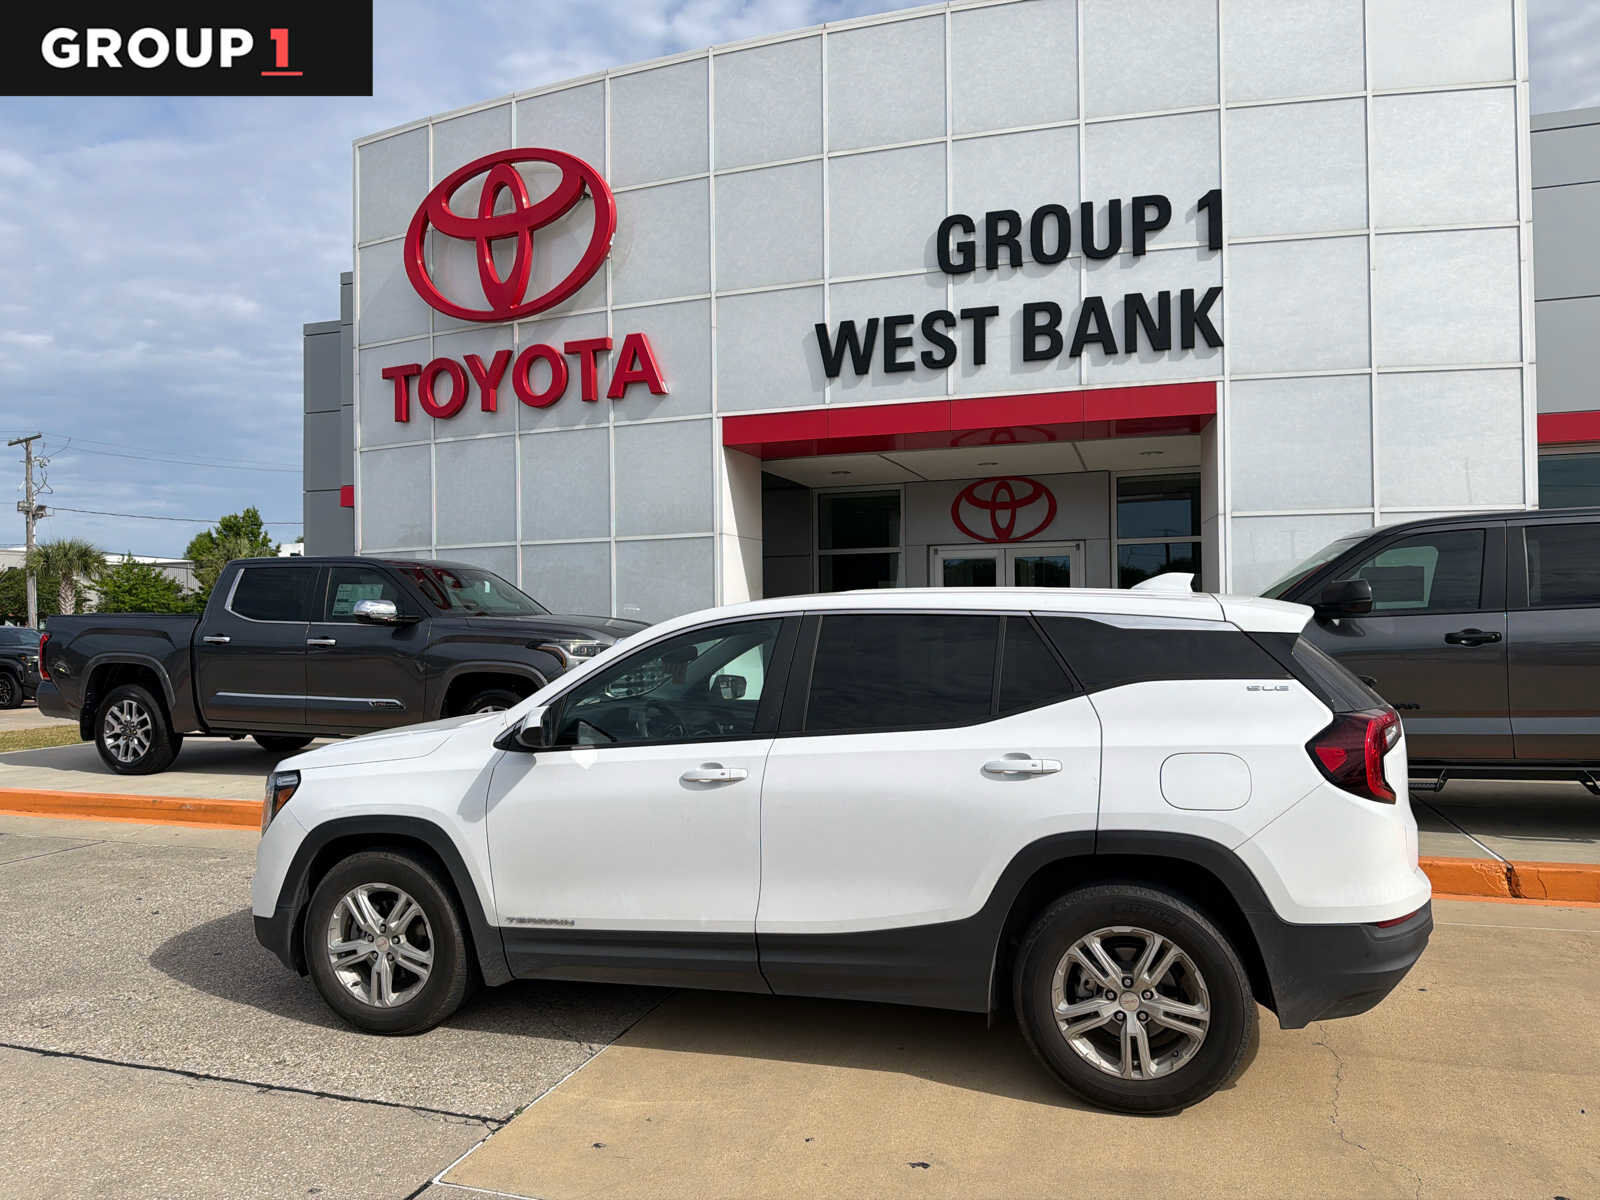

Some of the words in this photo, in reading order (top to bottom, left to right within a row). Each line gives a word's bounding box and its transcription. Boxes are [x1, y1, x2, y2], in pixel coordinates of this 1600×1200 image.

[936, 194, 1172, 277] GROUP
[1197, 188, 1223, 252] 1
[381, 332, 668, 422] TOYOTA
[814, 306, 999, 379] WEST
[1022, 286, 1225, 363] BANK
